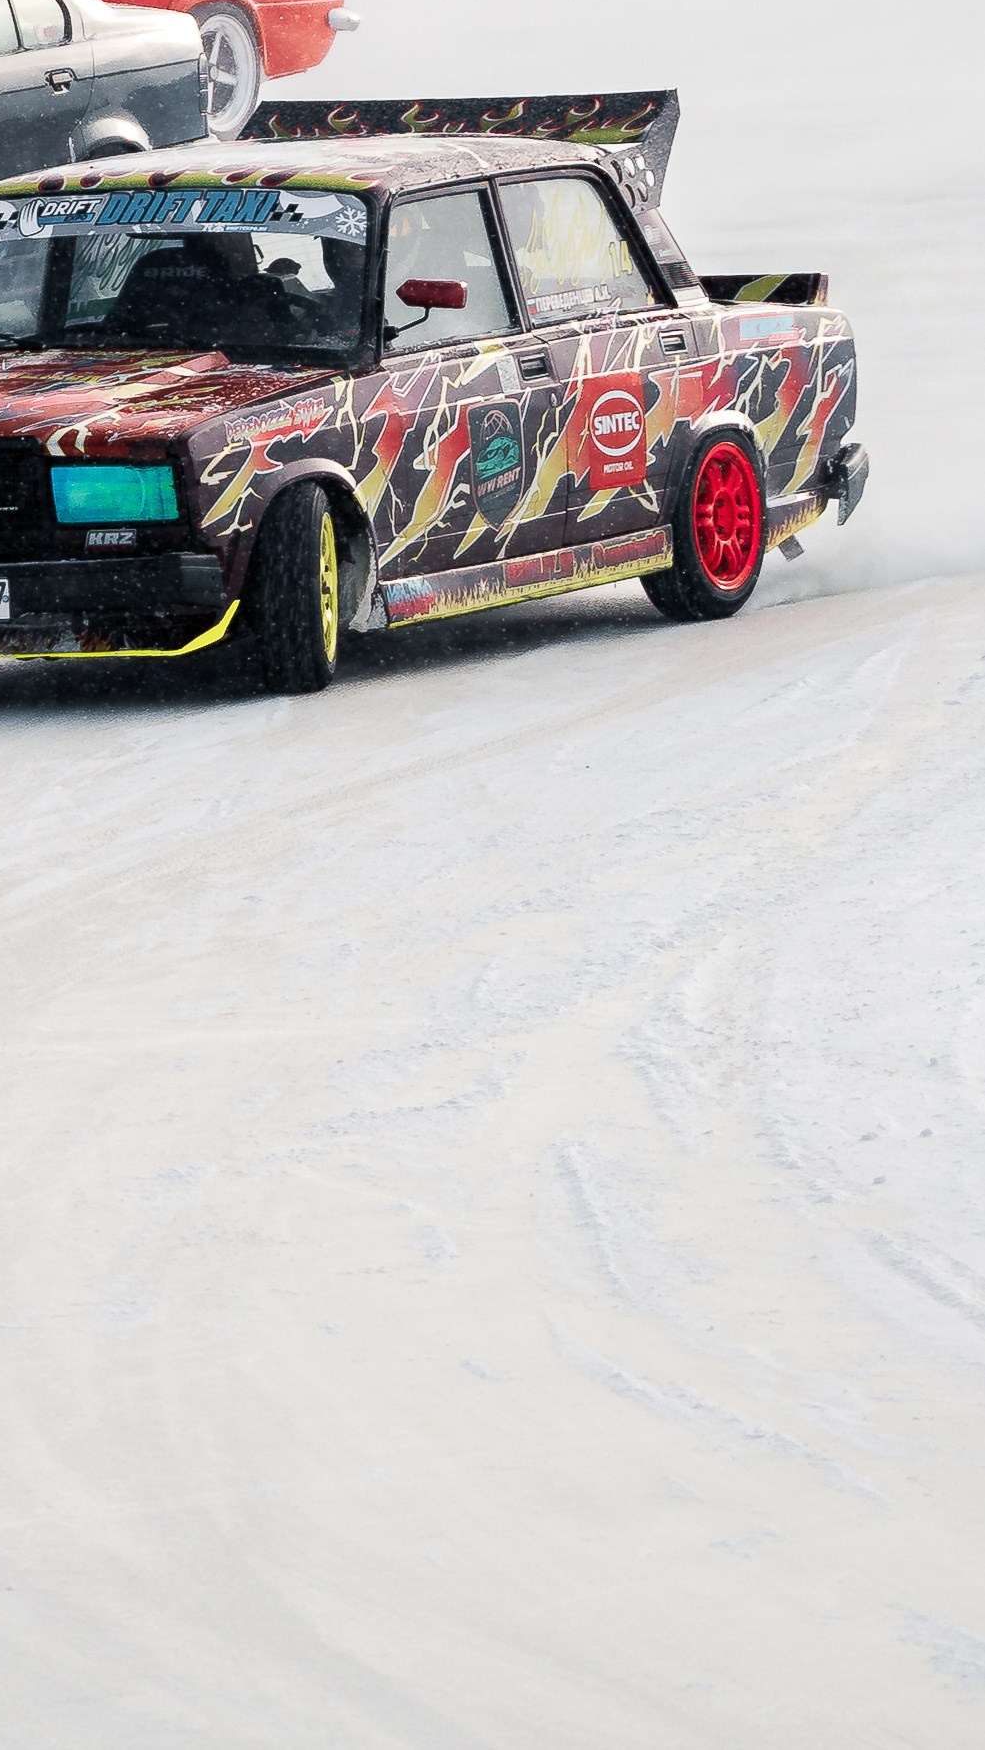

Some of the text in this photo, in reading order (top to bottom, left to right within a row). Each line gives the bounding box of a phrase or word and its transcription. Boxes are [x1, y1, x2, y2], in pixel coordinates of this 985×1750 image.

[41, 189, 281, 226] DRIFT DRIFT TAXI
[609, 240, 634, 278] 14
[142, 265, 210, 279] BRIDE
[593, 410, 641, 436] SINTEC
[496, 466, 522, 489] RENT
[603, 460, 634, 474] MOTOR OIL
[88, 532, 134, 545] KRZ
